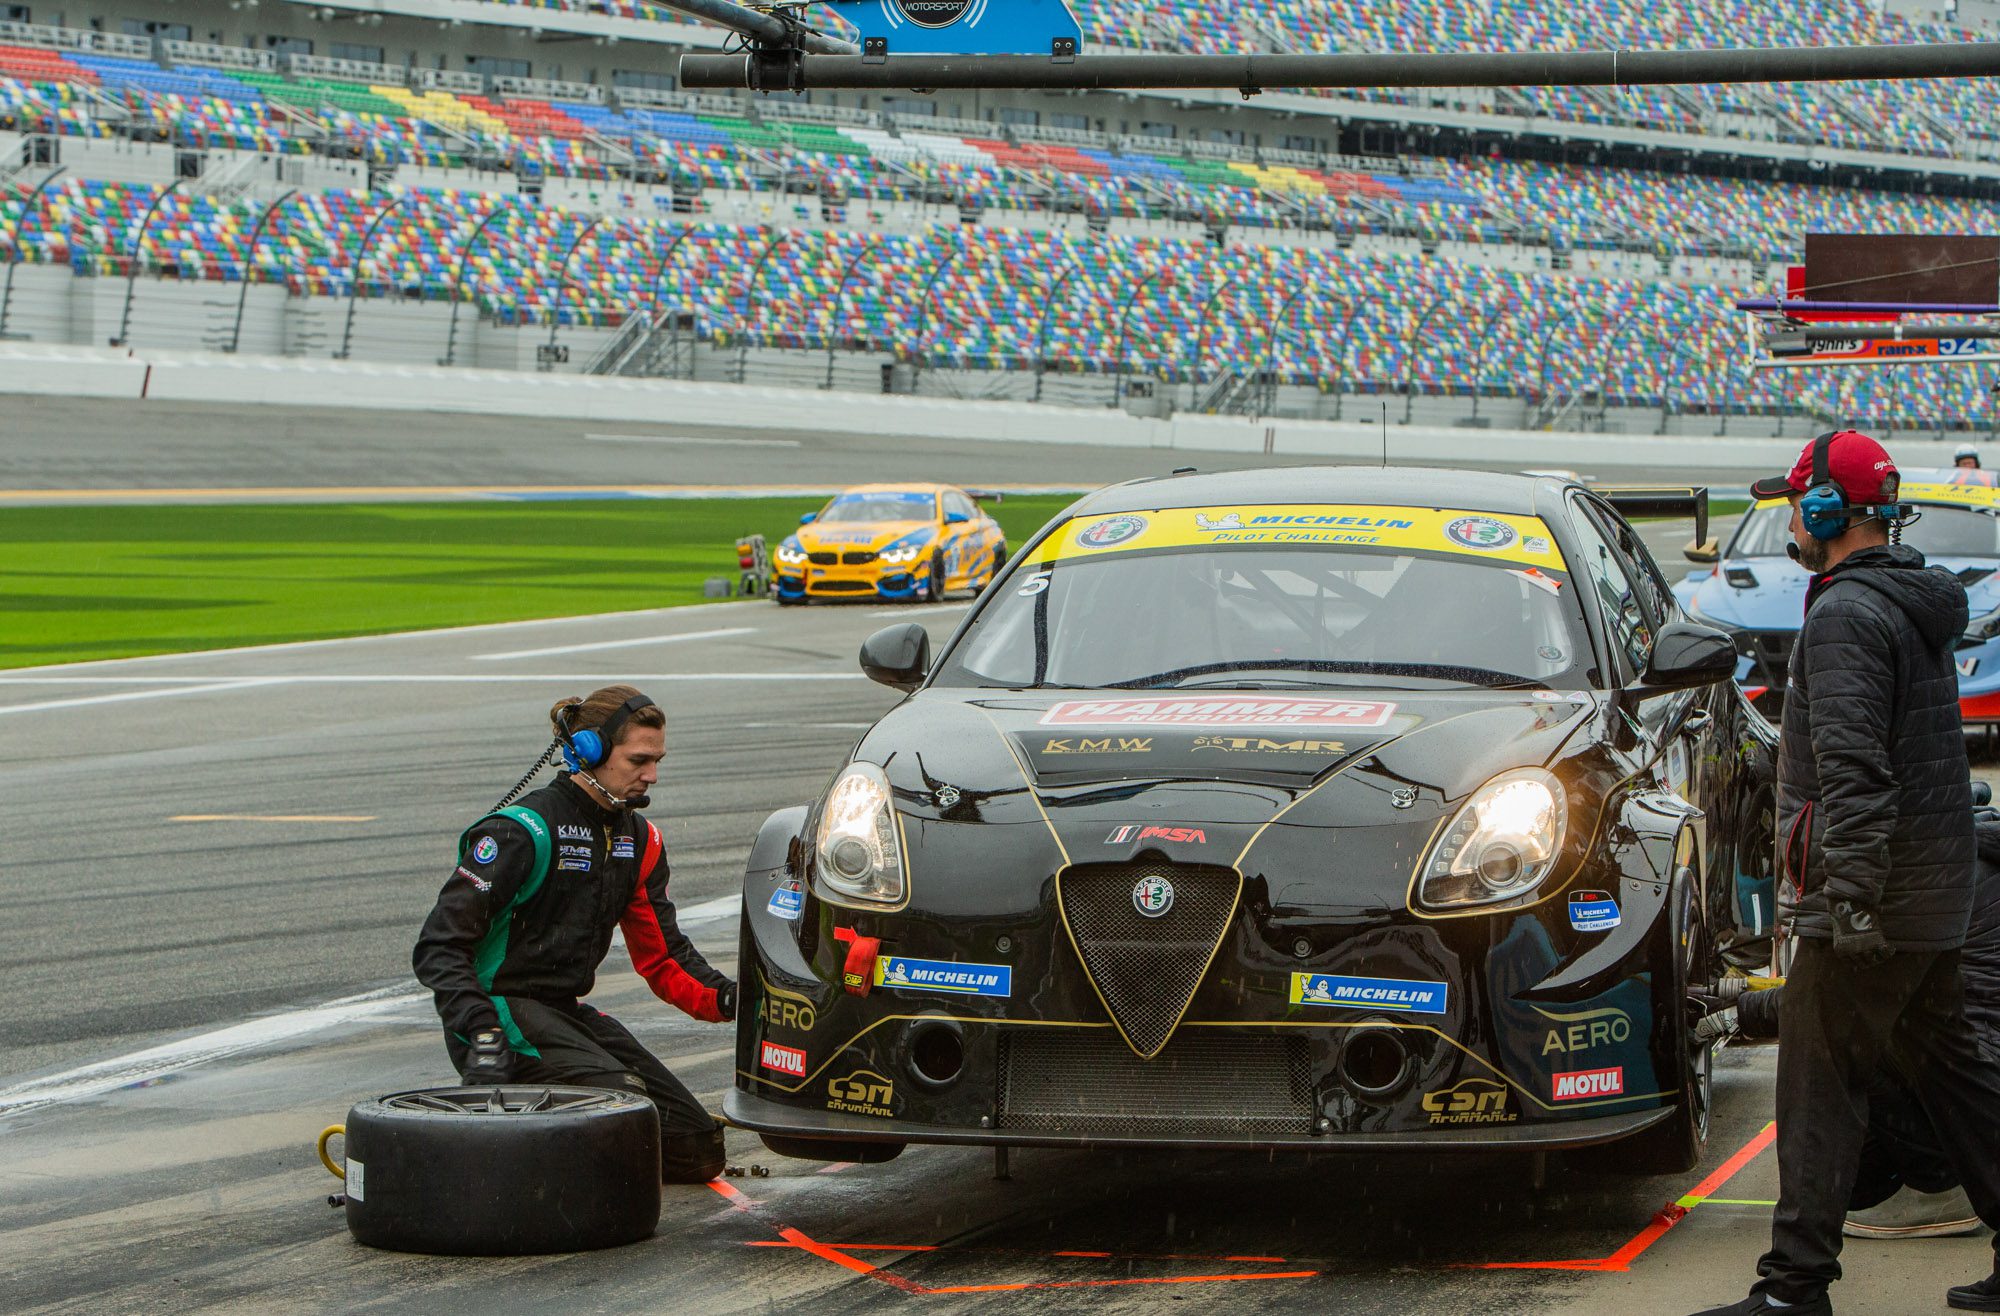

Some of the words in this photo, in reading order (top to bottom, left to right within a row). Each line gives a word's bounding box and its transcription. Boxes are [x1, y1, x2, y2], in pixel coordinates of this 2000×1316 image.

[905, 2, 965, 11] MOTORSPORT
[1940, 338, 1976, 355] 52
[1250, 515, 1414, 529] MICHELIN
[1213, 533, 1269, 542] PILOT
[1274, 532, 1381, 544] CHALLENGE
[1017, 570, 1053, 597] 5
[1066, 702, 1376, 717] HAMMER
[1120, 714, 1304, 723] NUTRITION
[1045, 737, 1153, 751] KMW
[1223, 737, 1347, 751] TMR
[557, 825, 592, 838] KMW
[1137, 826, 1207, 844] IMSA
[911, 968, 999, 987] MICHELIN
[1334, 985, 1434, 1004] MICHELIN
[758, 997, 815, 1032] AERO
[1541, 1017, 1630, 1056] AERO
[763, 1045, 804, 1073] MOTUL
[1556, 1071, 1620, 1097] MOTUL
